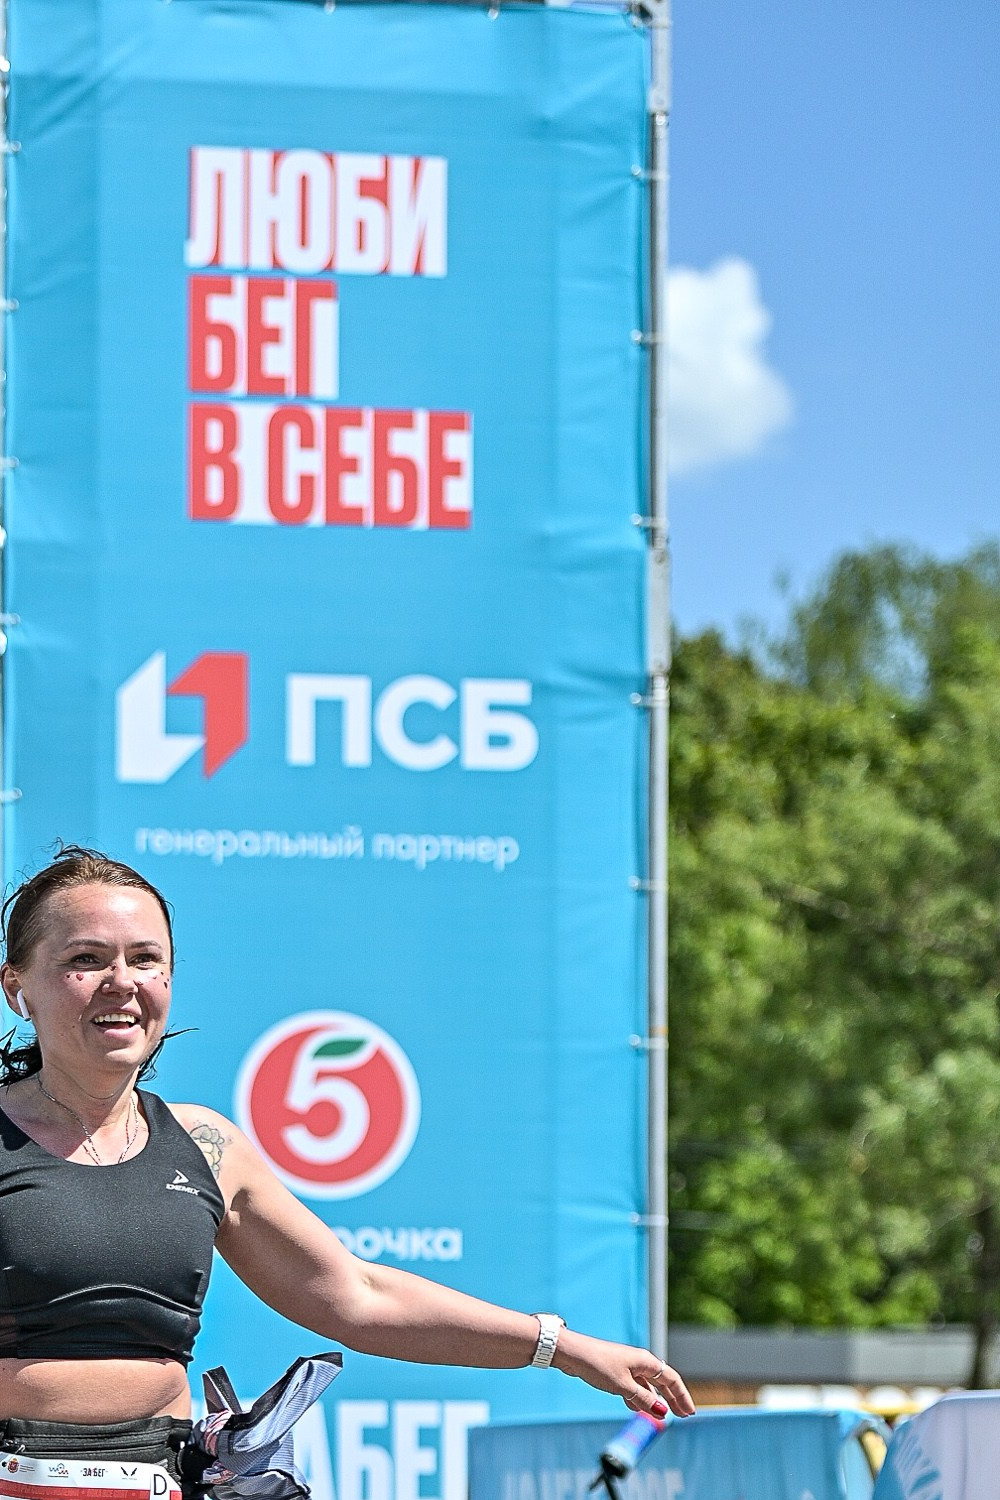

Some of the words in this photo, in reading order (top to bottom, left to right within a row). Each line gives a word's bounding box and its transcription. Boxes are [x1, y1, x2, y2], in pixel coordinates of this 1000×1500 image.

[186, 145, 448, 278] ЛЮБИ
[188, 275, 339, 398] БЕГ
[188, 402, 240, 522] В
[267, 404, 473, 530] СЕБЕ
[285, 671, 540, 773] ПСБ
[135, 824, 365, 866] генеральный
[371, 832, 520, 872] партнер
[153, 1473, 168, 1496] D
